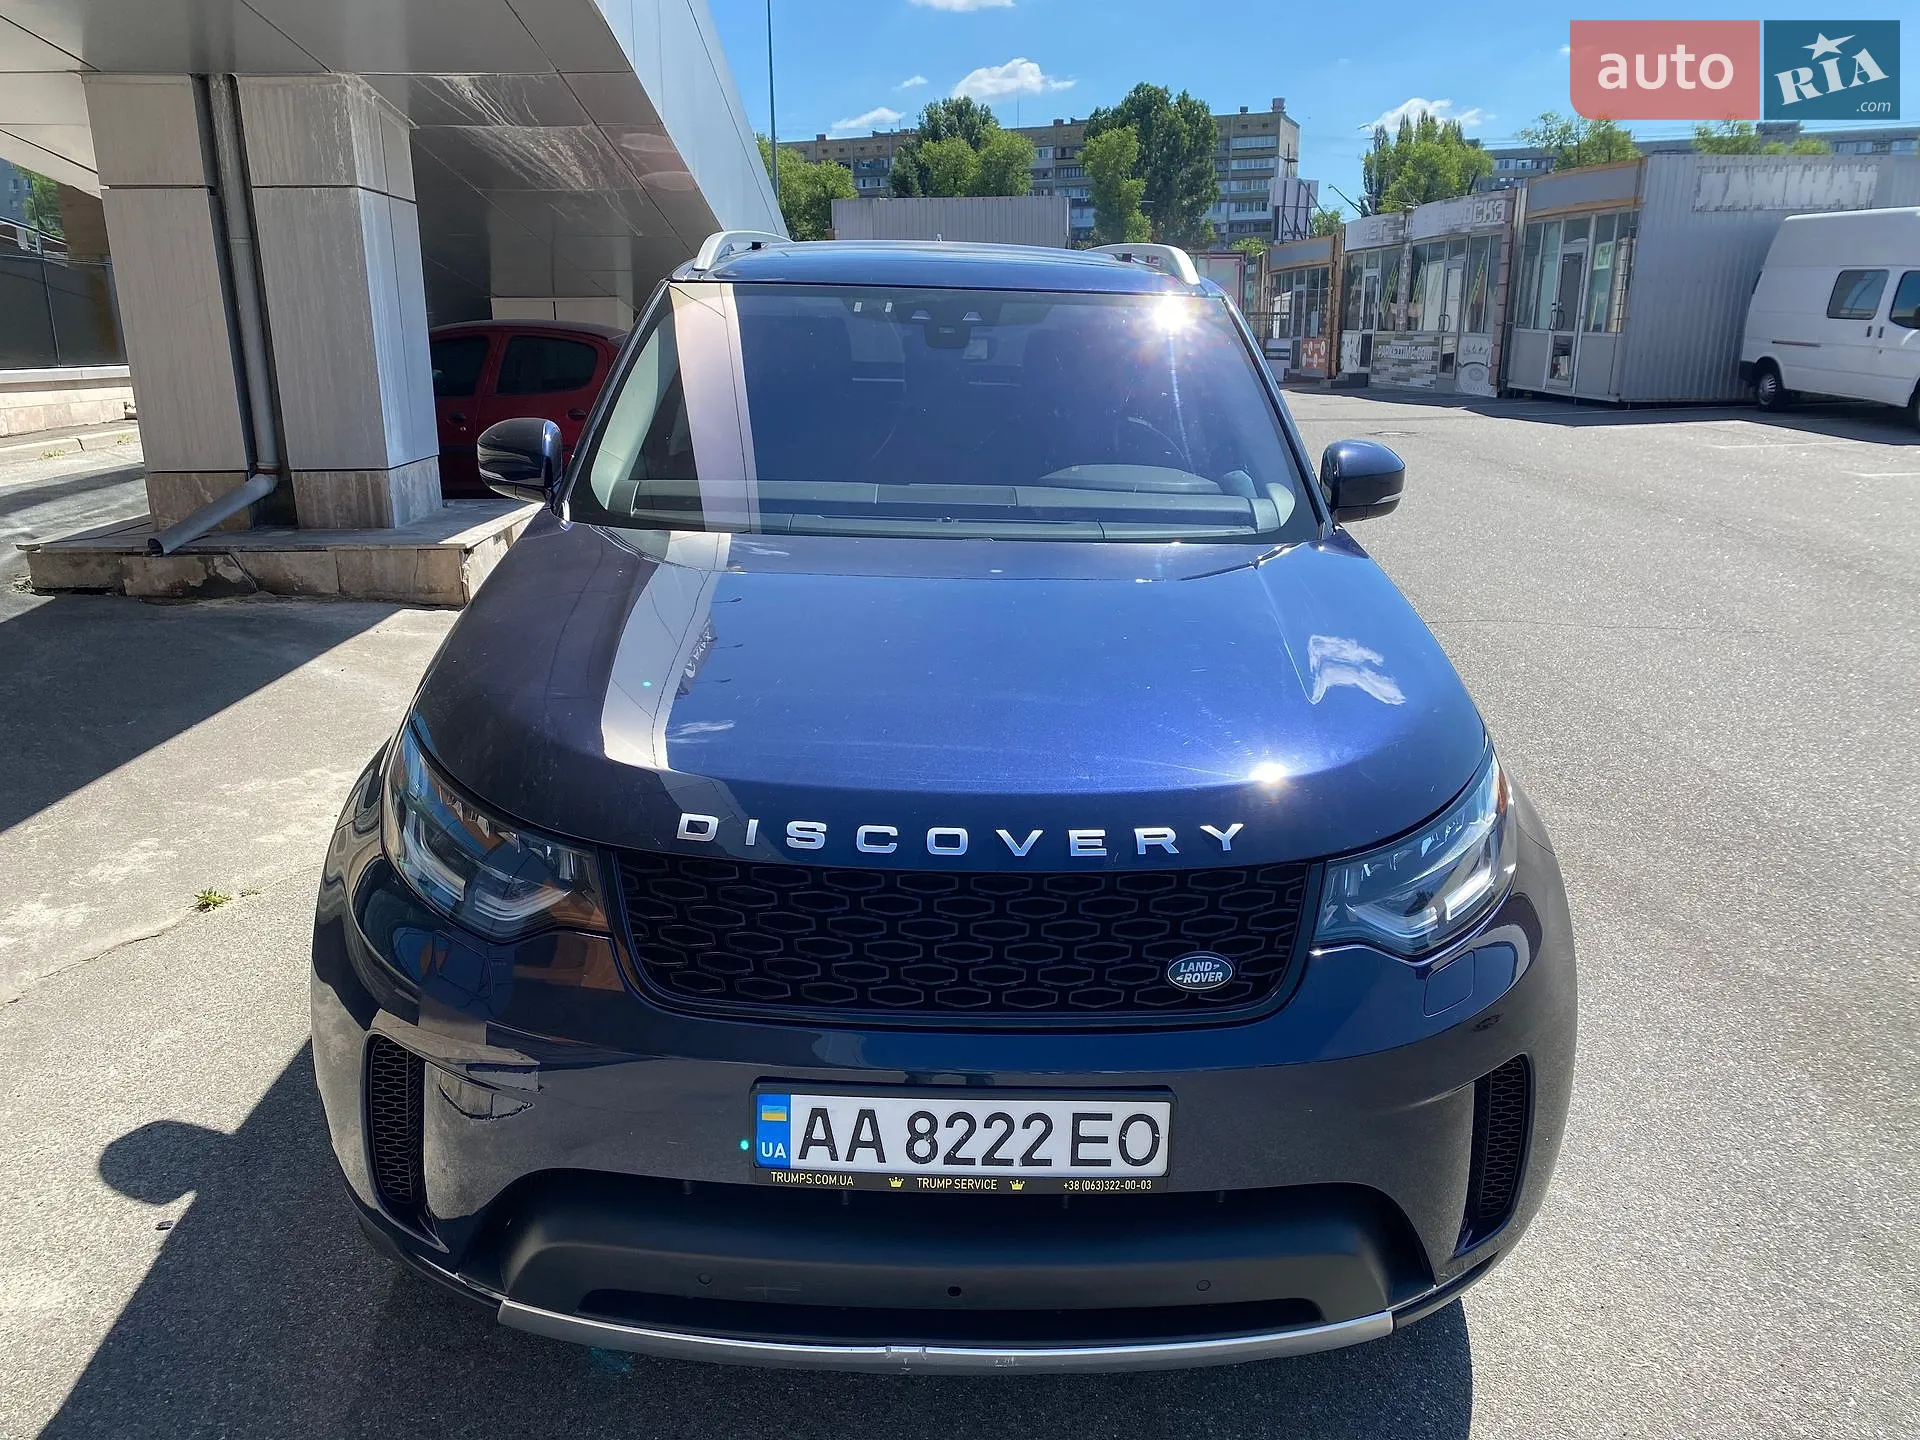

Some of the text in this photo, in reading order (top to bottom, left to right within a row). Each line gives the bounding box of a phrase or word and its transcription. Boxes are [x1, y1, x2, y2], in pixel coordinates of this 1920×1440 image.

[676, 812, 1244, 858] DISCOVERY
[1180, 961, 1213, 973] LAND
[1182, 971, 1223, 984] ROVER
[798, 1107, 1161, 1168] AA 8222 EO
[761, 1142, 787, 1159] UA
[771, 1171, 1152, 1192] TRUMPS.COM.UA TRUMP SERVICE +38 (063)322-00-03
